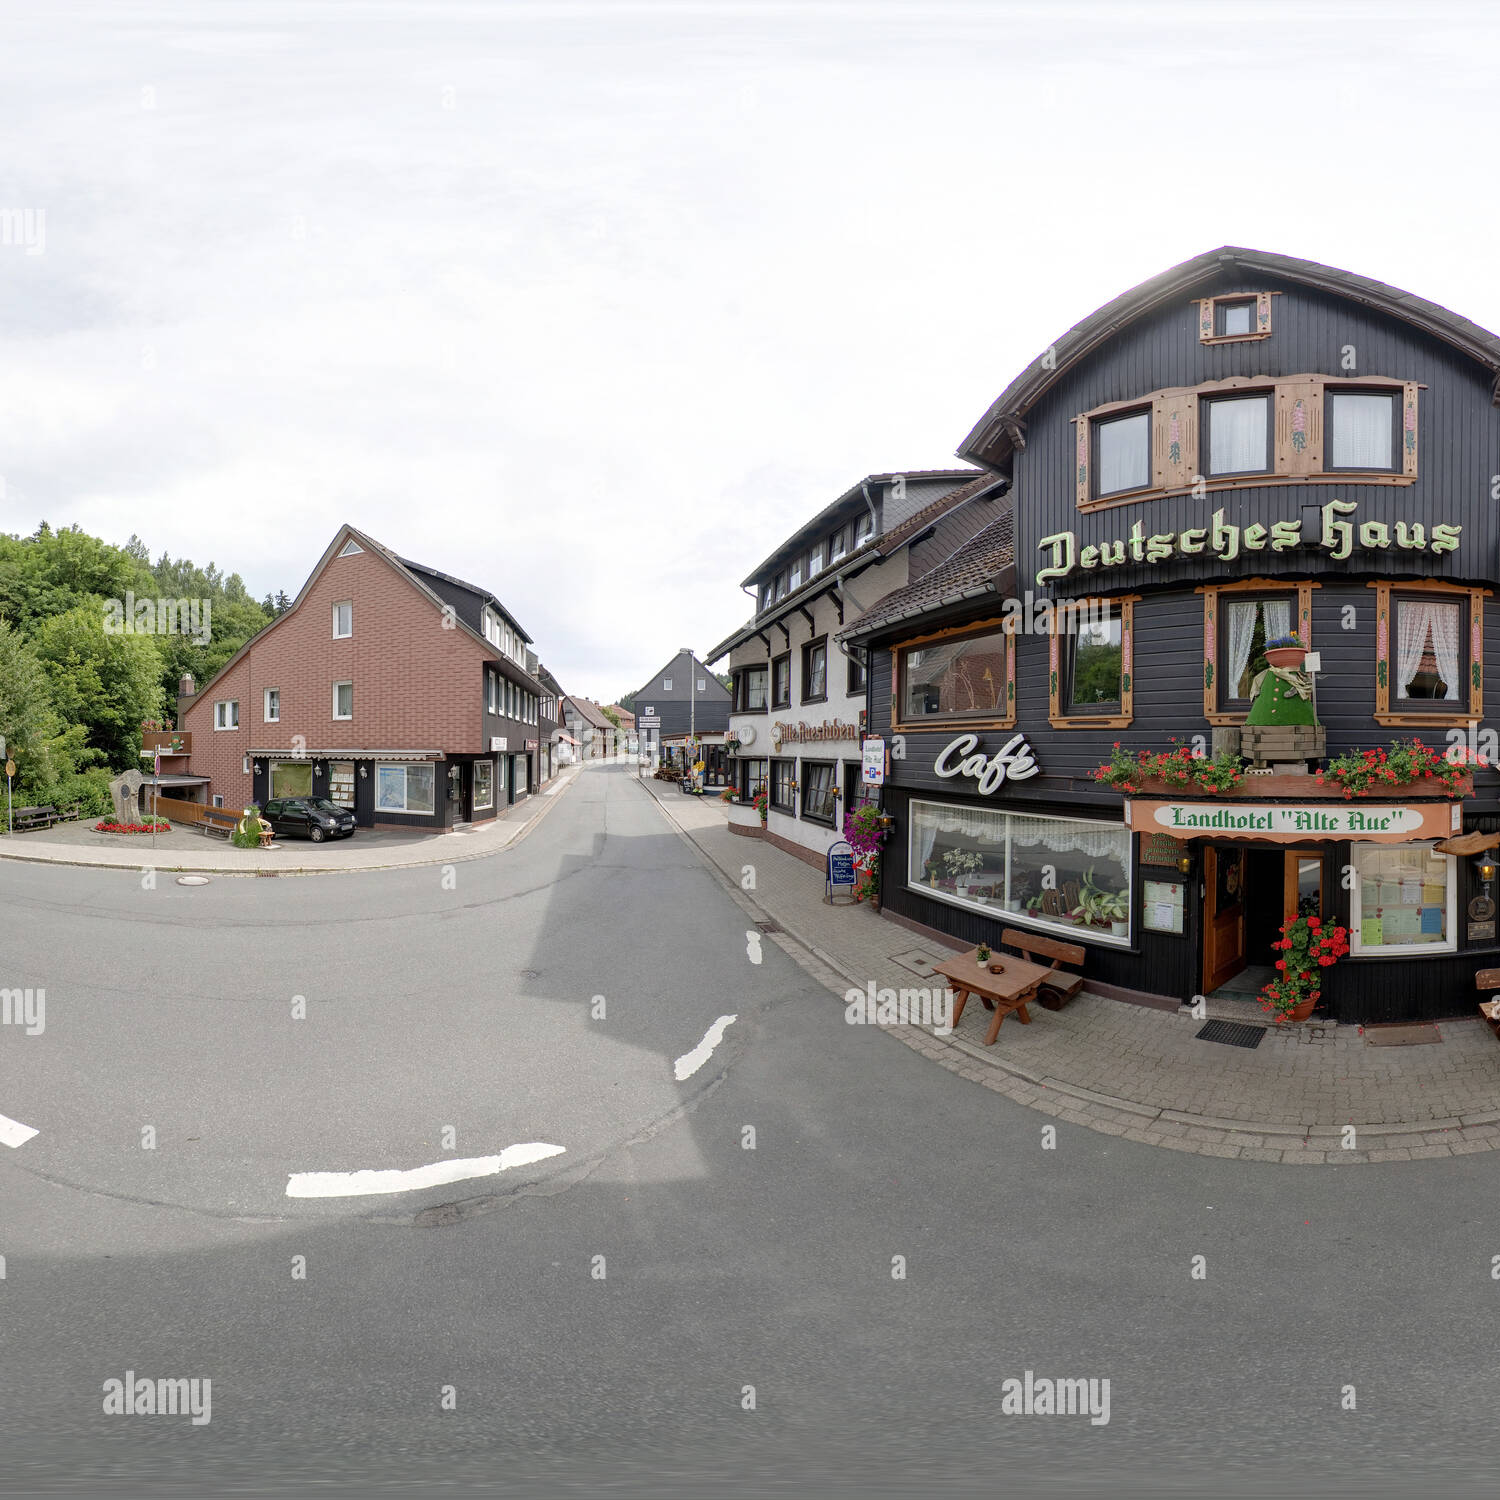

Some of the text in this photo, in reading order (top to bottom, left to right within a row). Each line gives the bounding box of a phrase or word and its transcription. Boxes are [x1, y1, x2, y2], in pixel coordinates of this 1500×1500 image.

[1036, 499, 1463, 588] Deutsches Haus
[933, 733, 1040, 796] Café
[1170, 806, 1404, 832] Landhotel "Alte Aue"
